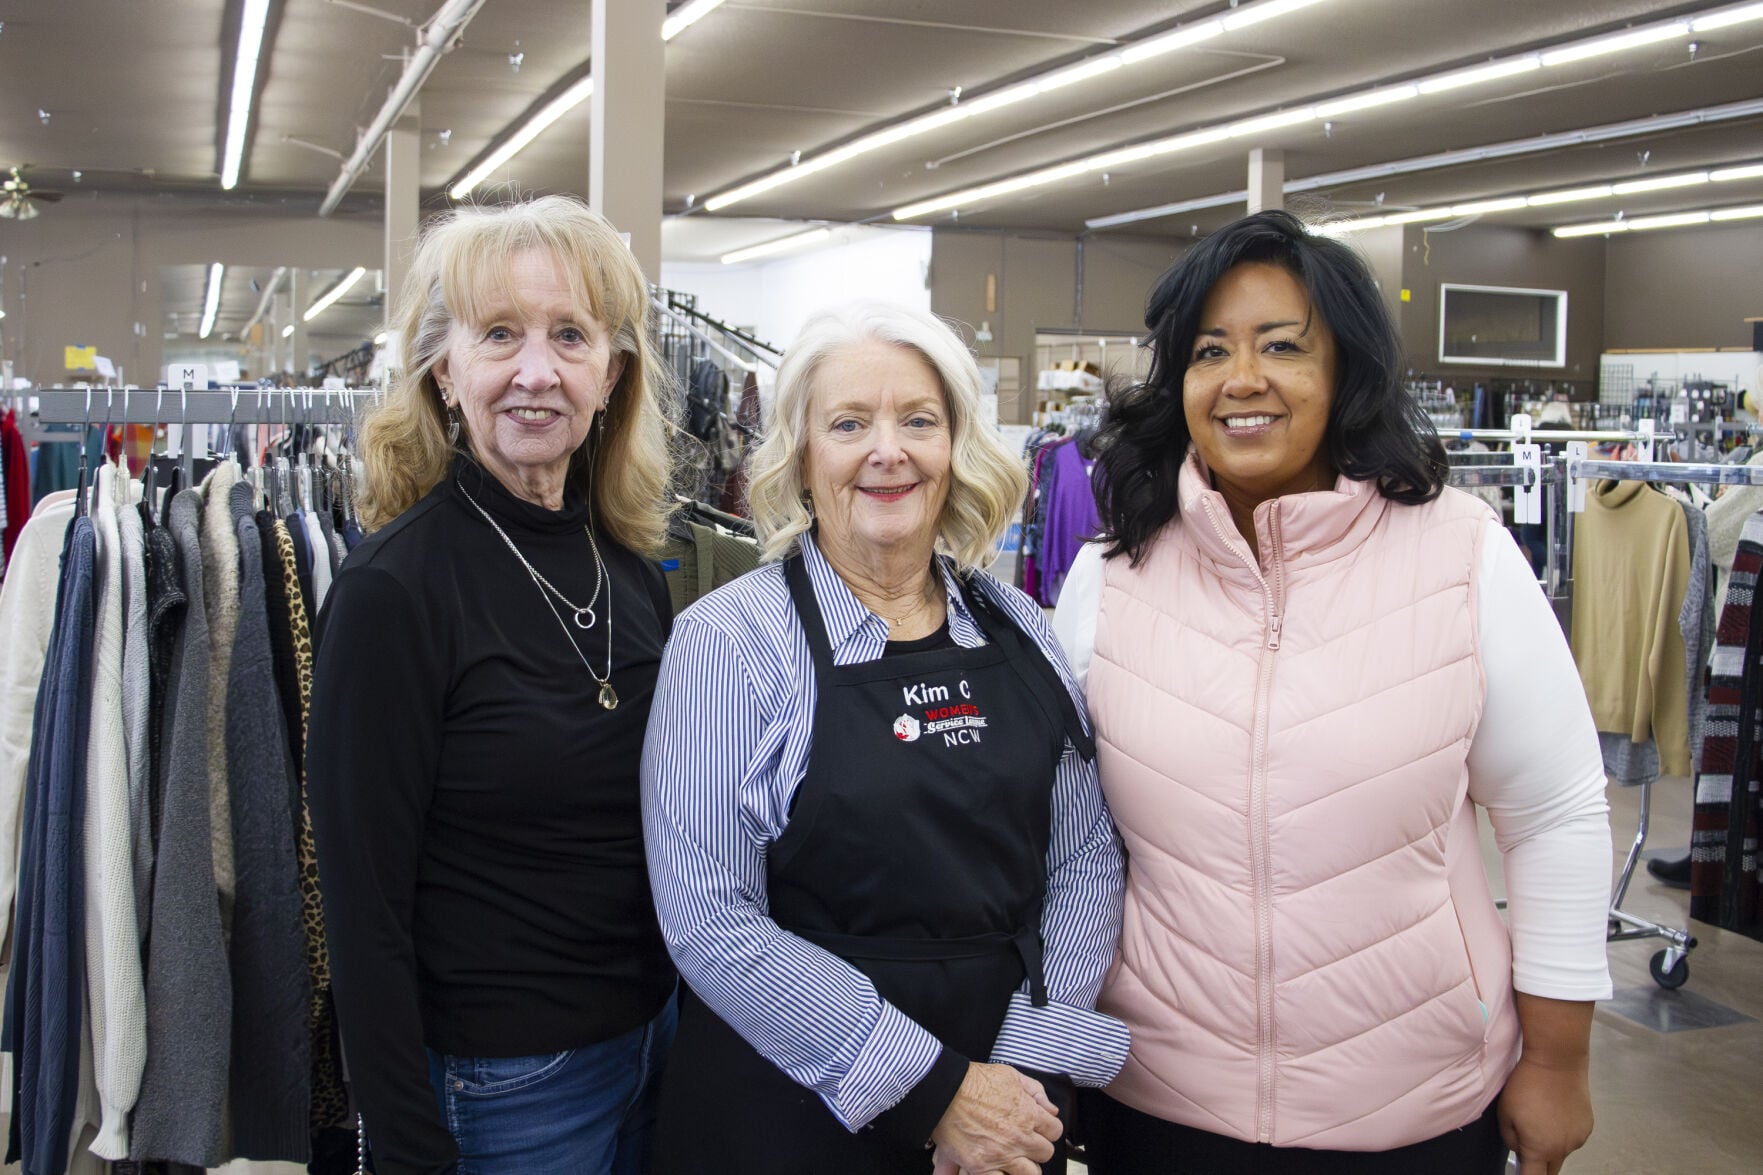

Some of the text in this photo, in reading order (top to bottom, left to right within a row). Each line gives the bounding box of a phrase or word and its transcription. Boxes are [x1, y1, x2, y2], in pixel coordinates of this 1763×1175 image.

[183, 368, 194, 380] M
[1522, 451, 1532, 461] M
[1575, 447, 1580, 456] L
[903, 680, 971, 706] Kim C
[943, 728, 981, 748] NCW
